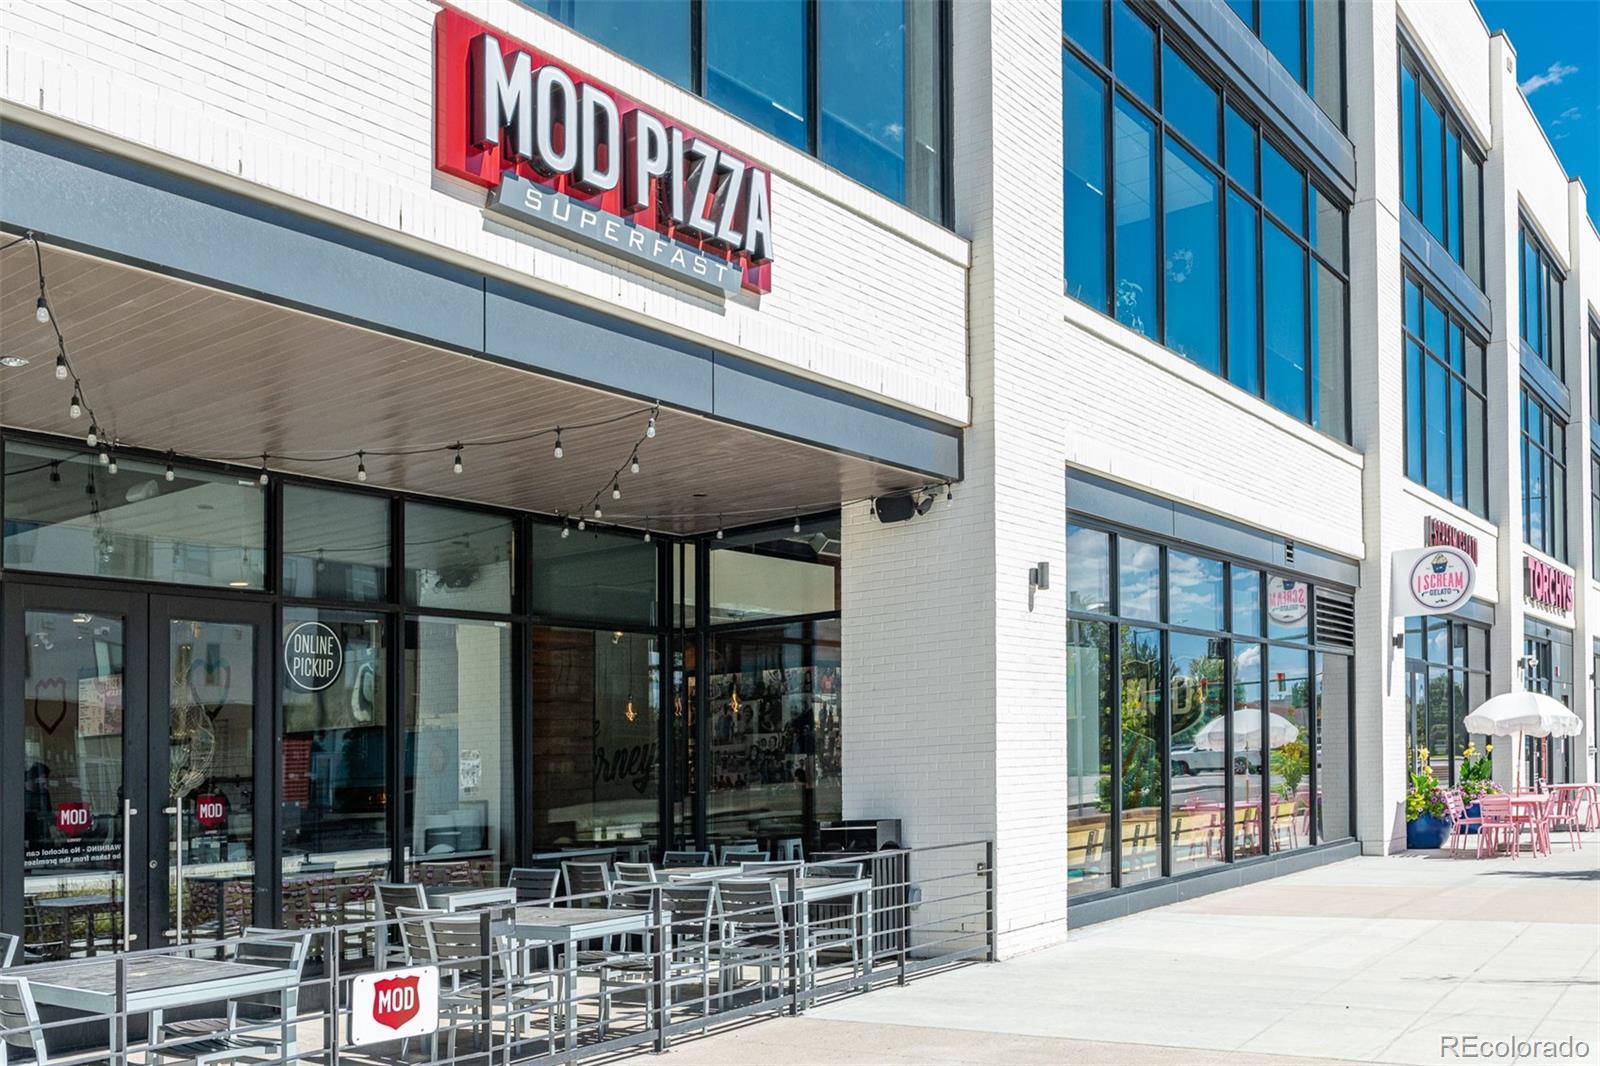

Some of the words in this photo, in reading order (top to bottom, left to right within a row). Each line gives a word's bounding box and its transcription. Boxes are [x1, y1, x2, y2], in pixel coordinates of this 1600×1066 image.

[483, 33, 619, 190] MOD
[636, 109, 774, 263] PIZZA
[524, 188, 728, 282] SUPERFAST
[1423, 571, 1464, 591] SCREAM
[294, 633, 334, 656] ONLINE
[293, 656, 334, 678] PICKUP
[1126, 675, 1193, 717] MD
[60, 809, 88, 826] MOD
[199, 803, 223, 819] MOD
[378, 986, 415, 1015] MOD
